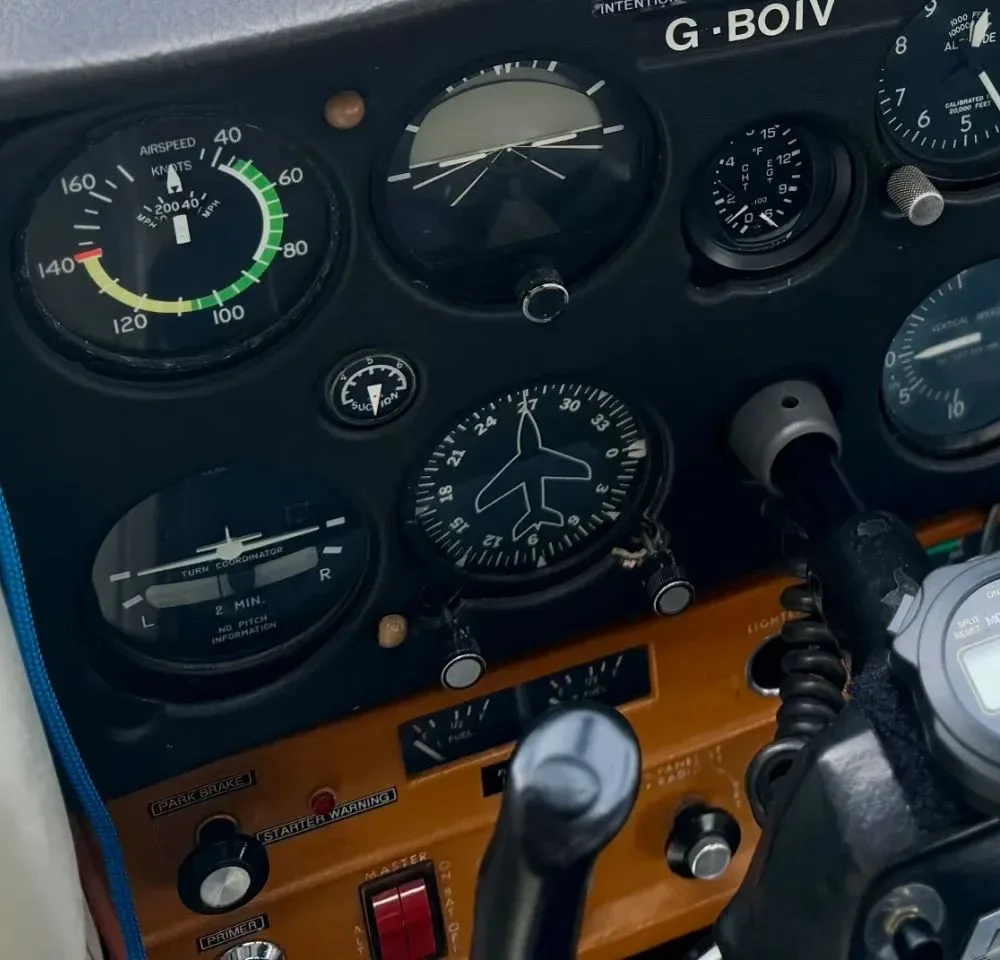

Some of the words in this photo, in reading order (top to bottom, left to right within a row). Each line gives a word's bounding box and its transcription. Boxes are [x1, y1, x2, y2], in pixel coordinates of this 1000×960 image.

[950, 13, 968, 27] 1000
[895, 36, 908, 54] 8
[896, 88, 906, 106] 7
[945, 95, 984, 109] CALIBRATED
[918, 109, 930, 128] 6
[949, 105, 972, 115] 20,000
[960, 114, 972, 132] 5
[213, 126, 242, 146] 40
[760, 127, 776, 140] 15
[140, 136, 196, 156] AIRSPEED
[726, 156, 736, 167] 4
[776, 153, 792, 166] 12
[61, 173, 97, 195] 160
[278, 167, 304, 186] 60
[778, 184, 788, 195] 9
[154, 202, 180, 215] 200
[182, 198, 200, 210] 40
[726, 194, 736, 204] 2
[202, 200, 221, 218] MPH
[744, 212, 754, 224] 0
[136, 213, 158, 228] MPH
[282, 240, 309, 258] 80
[38, 256, 76, 280] 140
[212, 304, 246, 325] 100
[113, 314, 148, 334] 120
[885, 351, 896, 368] 0
[352, 392, 399, 412] SUCION
[559, 398, 582, 412] 30
[899, 388, 910, 404] 5
[517, 398, 539, 414] 27
[947, 401, 965, 420] 10
[474, 415, 498, 436] 24
[590, 413, 610, 432] 33
[446, 448, 466, 468] 21
[605, 448, 619, 458] 0
[438, 484, 454, 504] 18
[596, 483, 610, 494] 3
[450, 516, 471, 534] 15
[483, 534, 504, 548] 12
[182, 565, 210, 578] TURN
[215, 546, 284, 570] COORDINATOR
[319, 568, 332, 582] R
[216, 606, 224, 616] 2
[234, 595, 266, 612] MIN.
[142, 615, 155, 629] L
[218, 624, 232, 634] NO
[238, 614, 268, 630] PITCH
[211, 621, 278, 645] INFORMATION
[160, 791, 196, 812] PARK
[198, 776, 244, 798] BRAKE
[264, 813, 326, 842] STARTER
[328, 792, 390, 821] WARNING
[364, 852, 428, 881] MASTER
[206, 920, 257, 946] PRIMER
